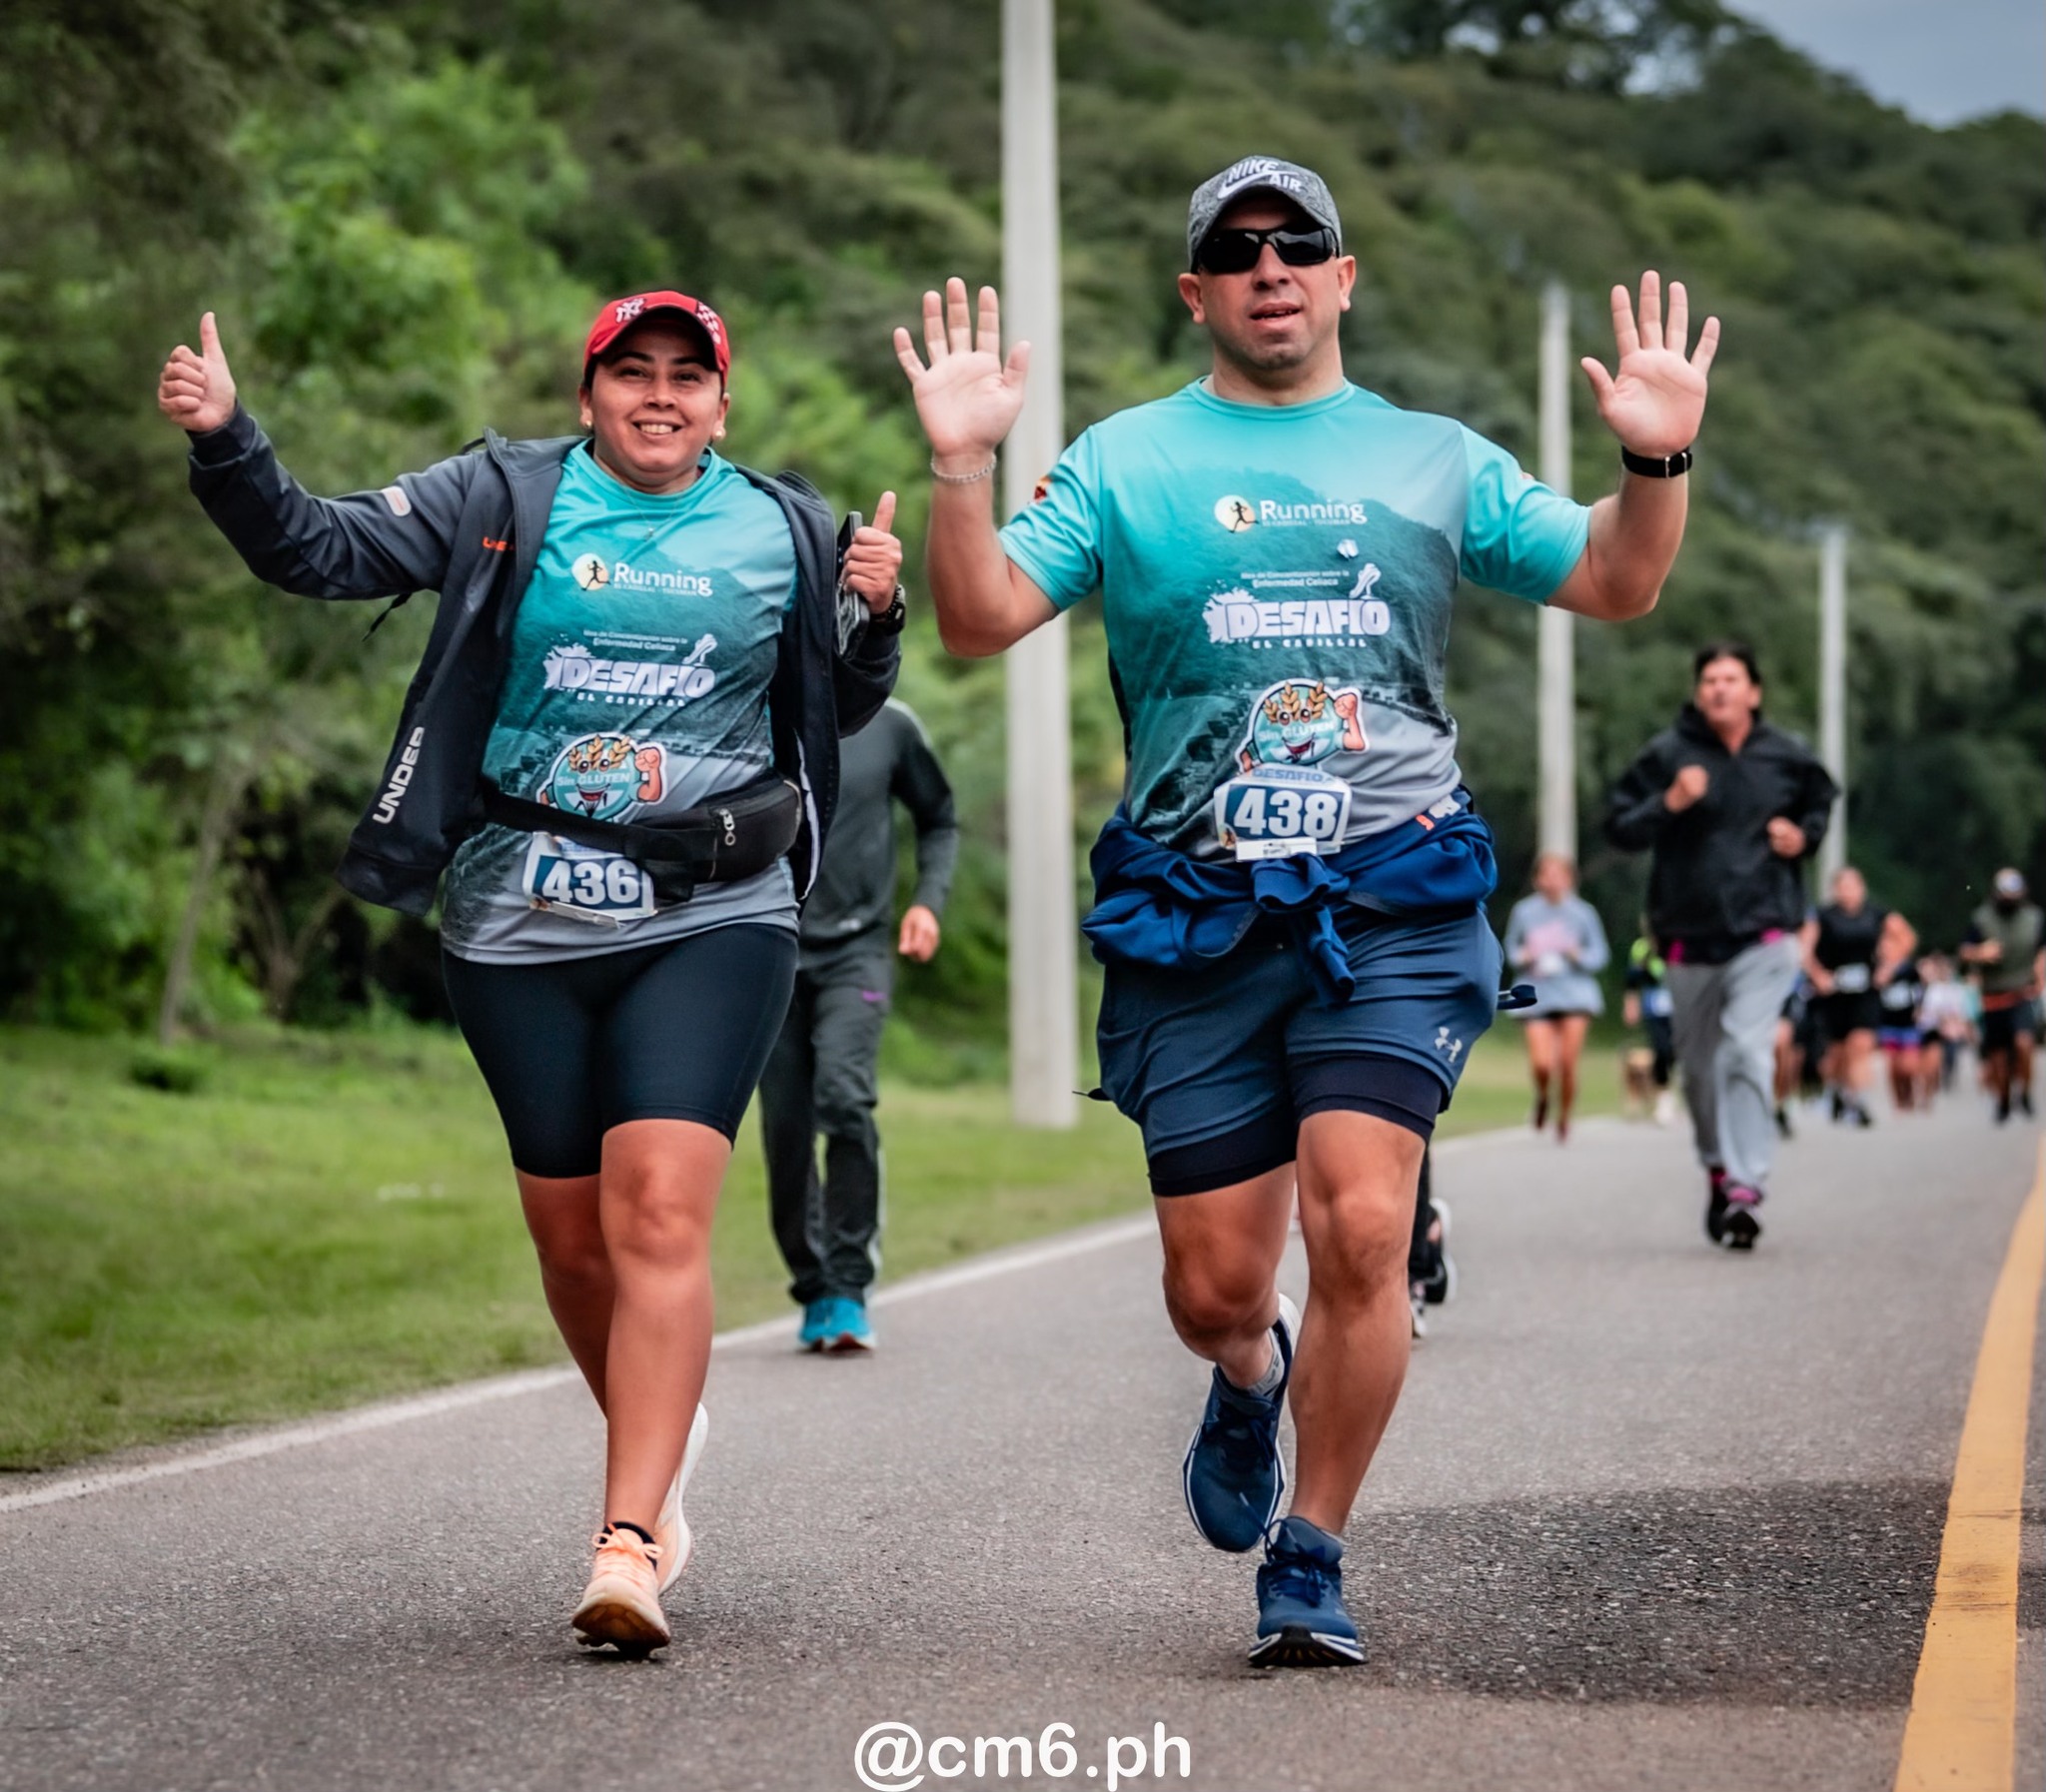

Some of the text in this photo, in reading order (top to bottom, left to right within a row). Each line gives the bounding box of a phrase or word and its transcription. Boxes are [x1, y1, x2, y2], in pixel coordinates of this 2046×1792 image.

[1228, 159, 1279, 184] NIKE
[1269, 174, 1303, 192] AIR
[1260, 498, 1368, 524] Running
[613, 562, 713, 597] Running
[1258, 719, 1337, 743] Sin GLUTEN
[556, 771, 630, 787] Sin GLUTEN
[1233, 787, 1339, 840] 438
[541, 859, 640, 906] 436
